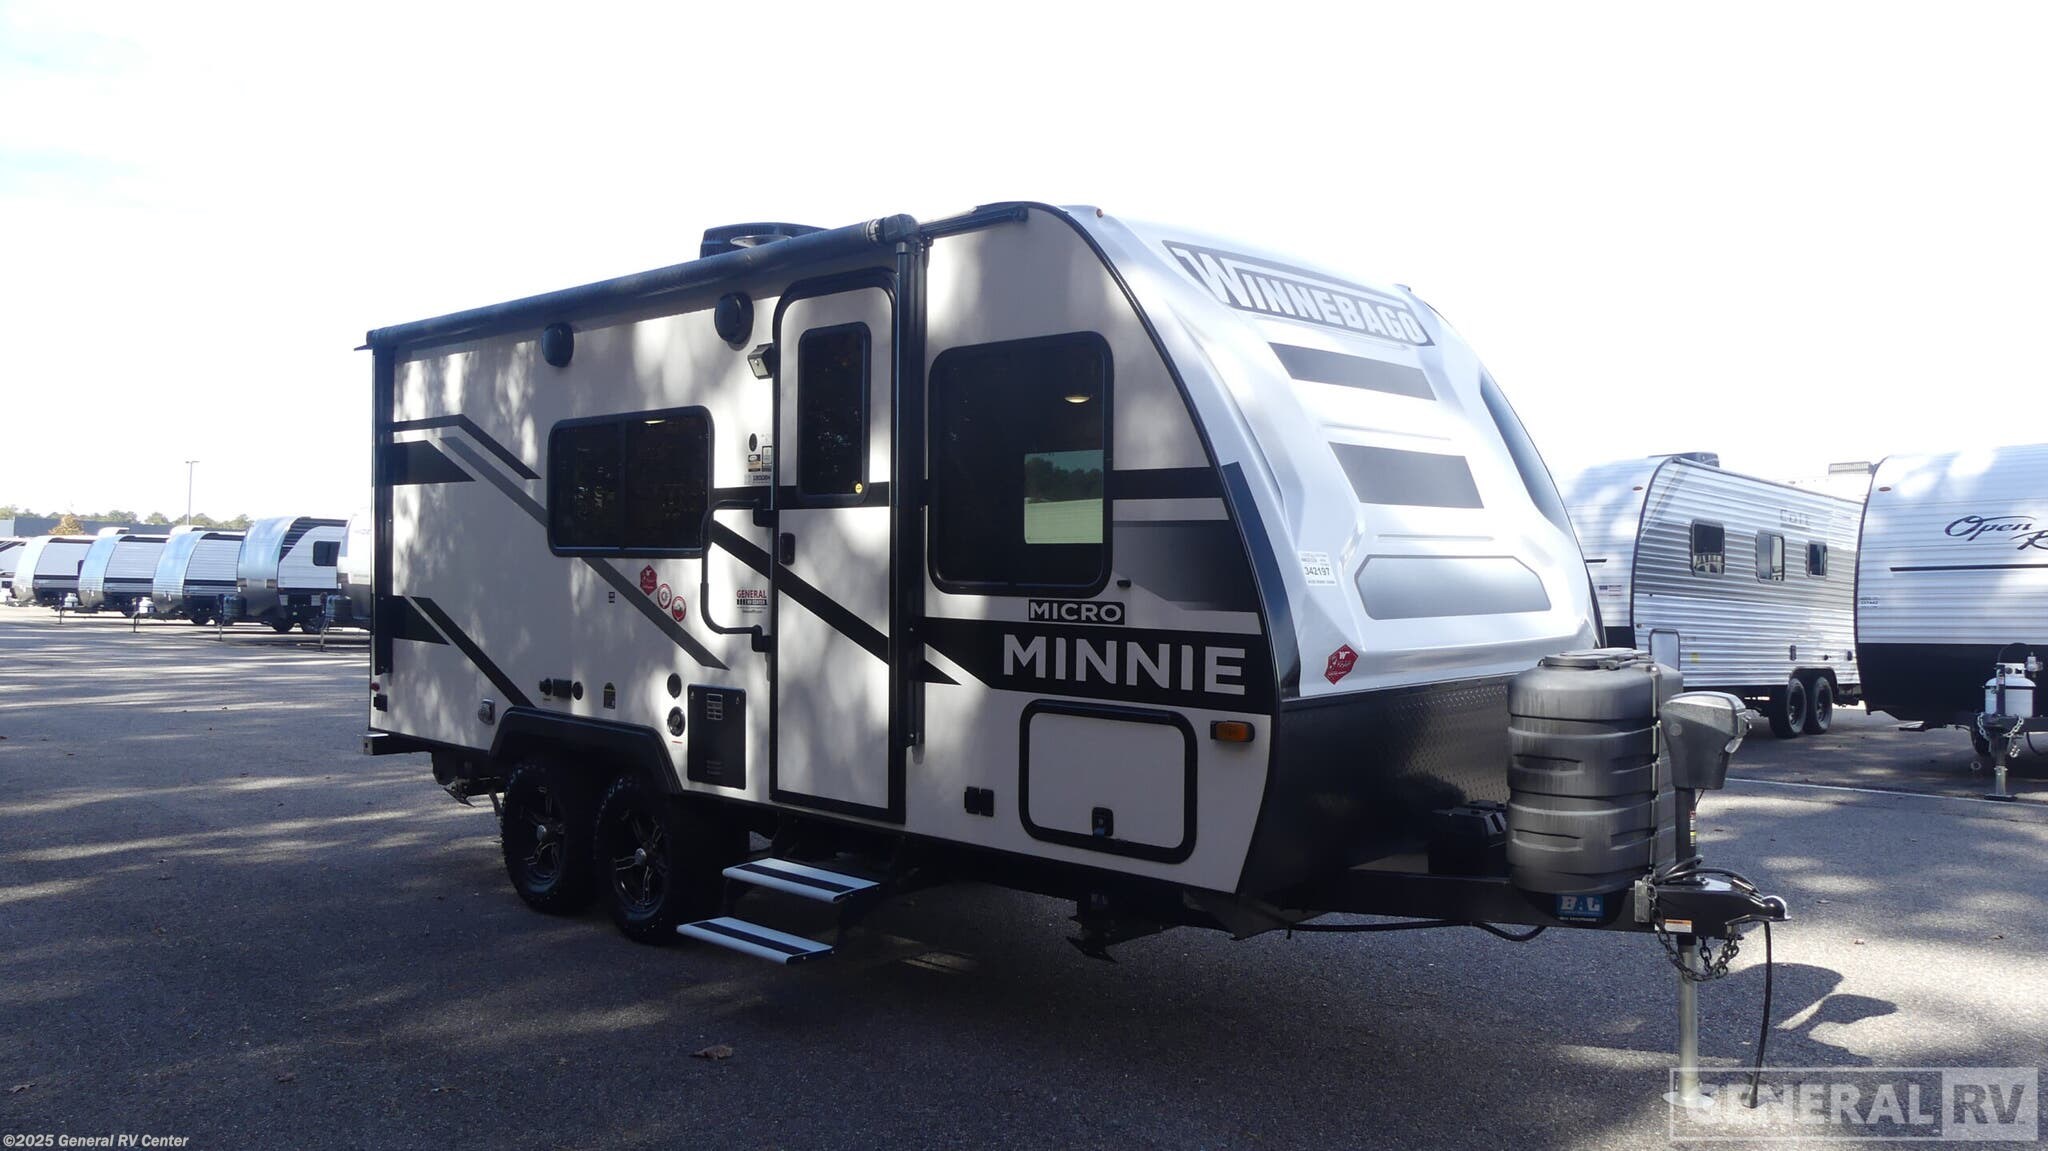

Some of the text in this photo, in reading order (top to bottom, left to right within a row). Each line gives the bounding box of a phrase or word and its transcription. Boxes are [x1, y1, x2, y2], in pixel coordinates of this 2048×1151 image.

[1170, 247, 1429, 344] WINNEBAGO
[1944, 515, 2037, 541] Open
[736, 589, 767, 599] GENERAL
[1030, 602, 1122, 622] MICRO
[1003, 633, 1245, 696] MINNIE
